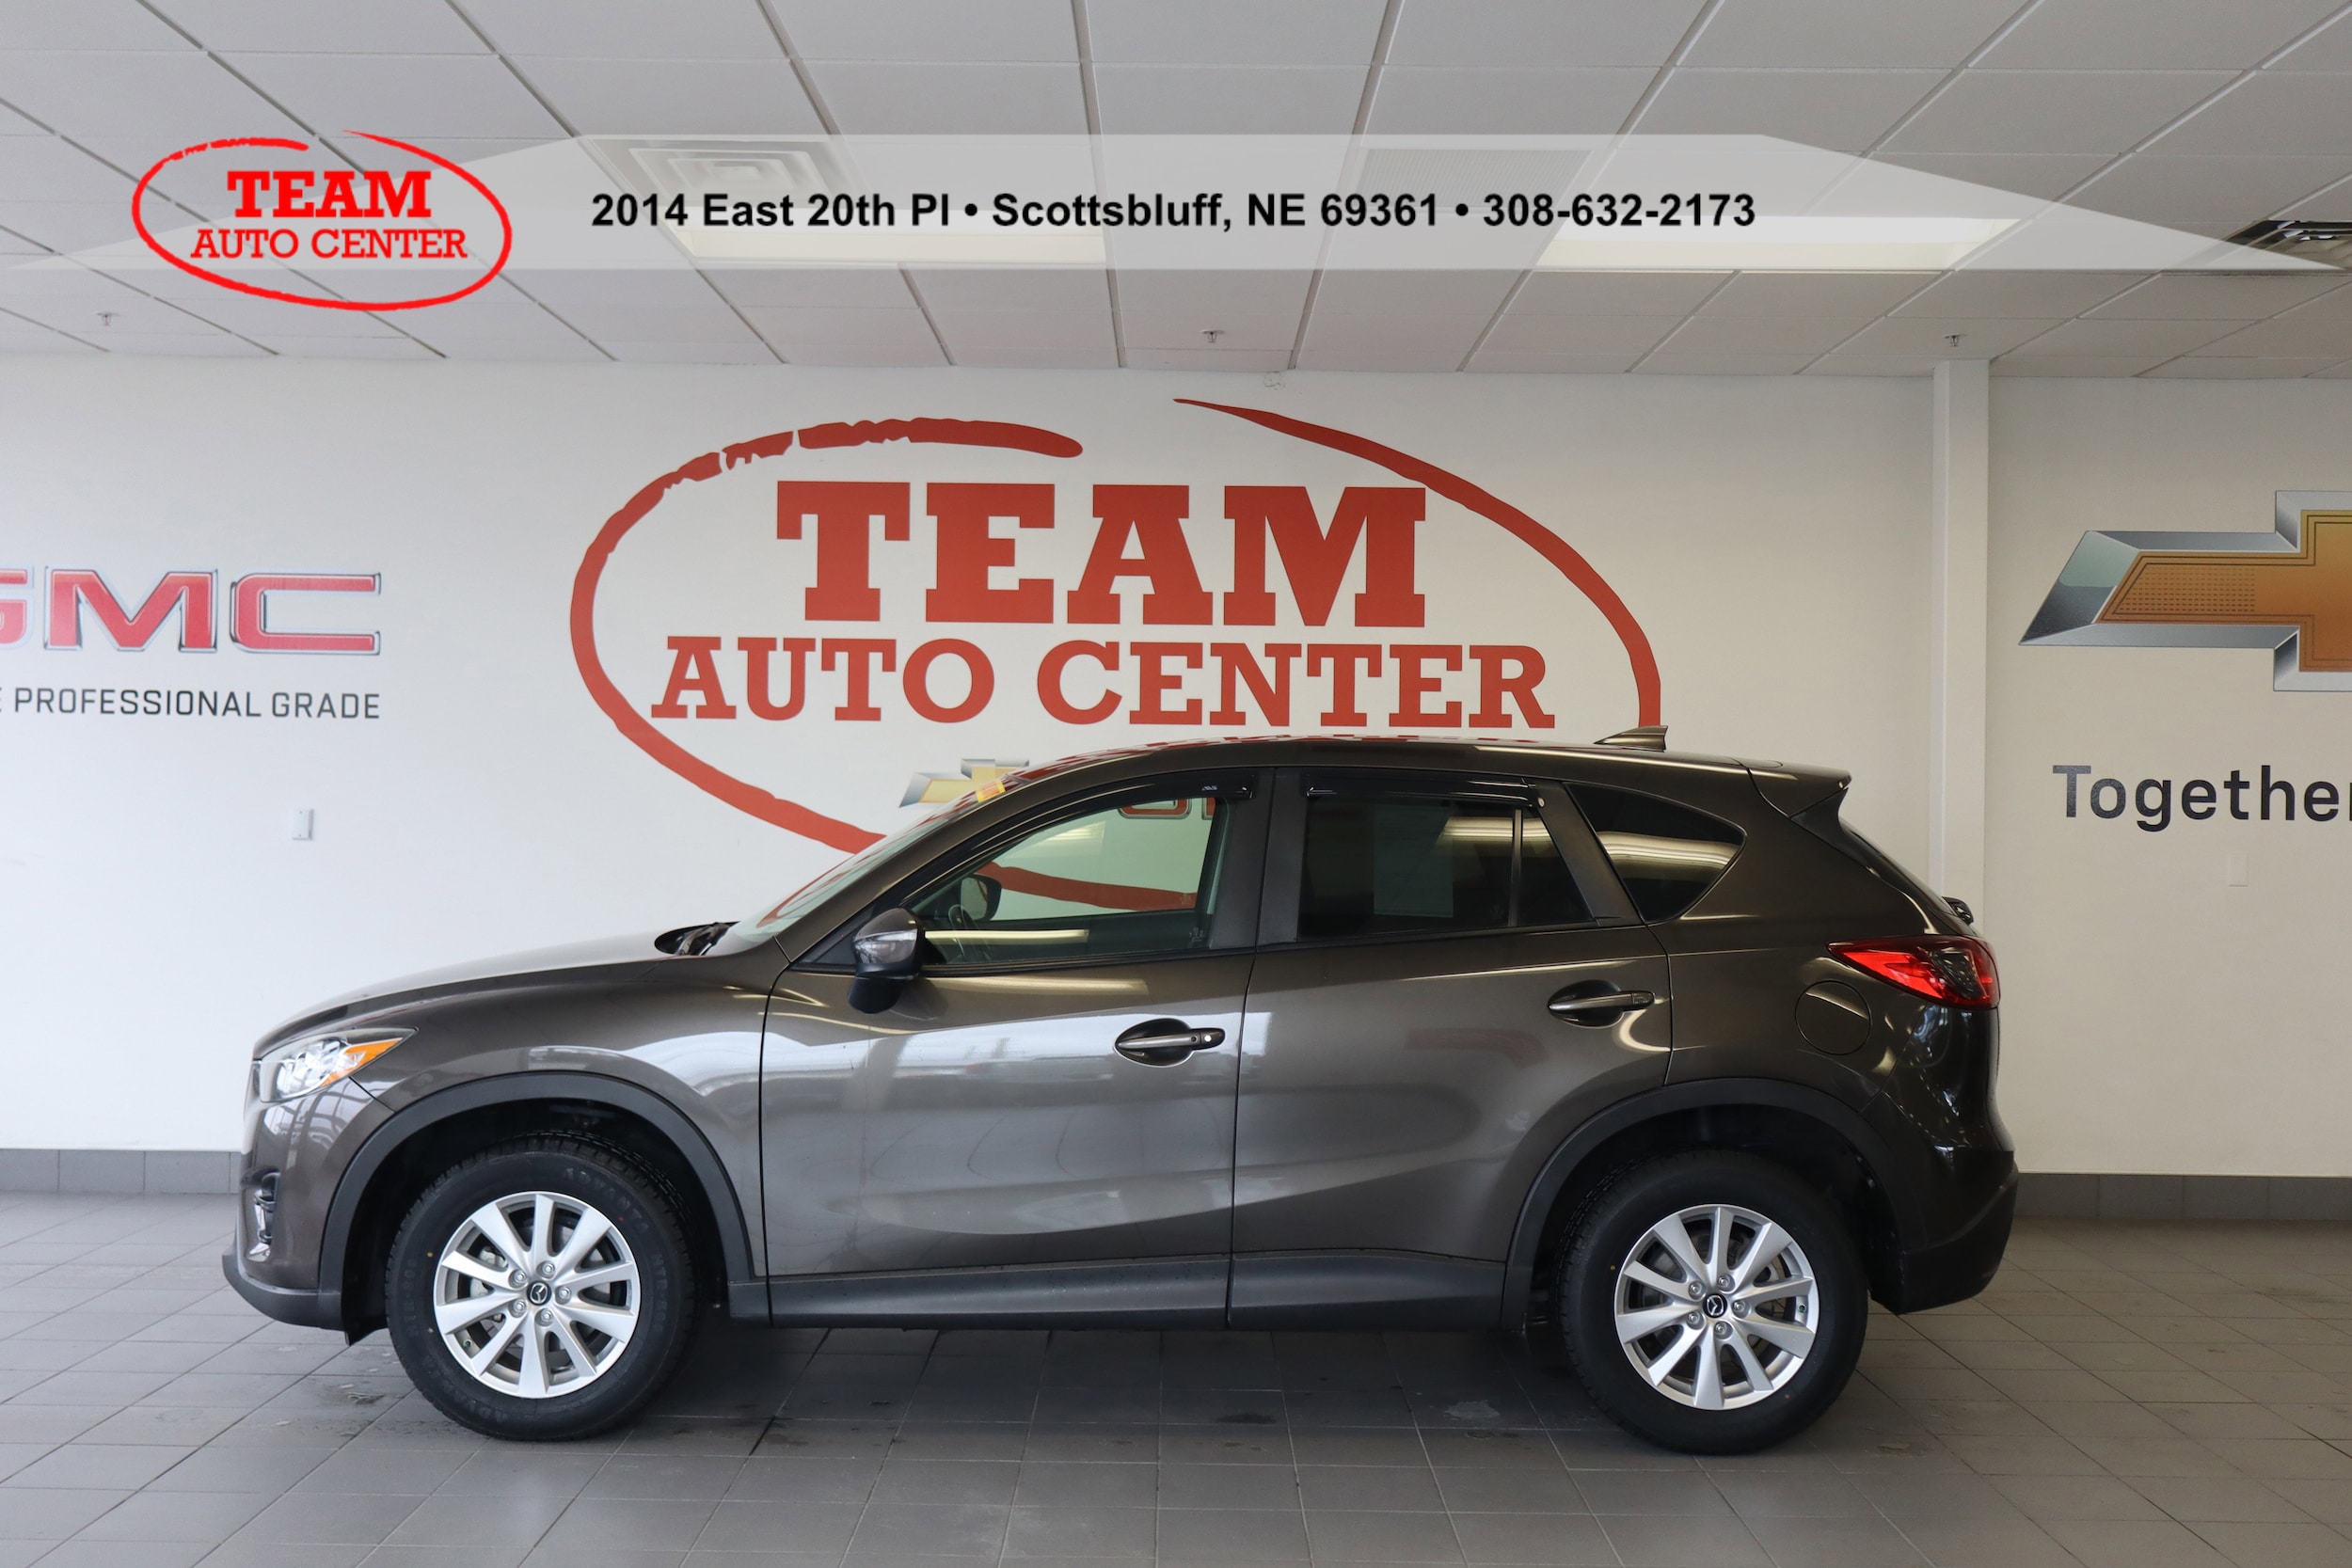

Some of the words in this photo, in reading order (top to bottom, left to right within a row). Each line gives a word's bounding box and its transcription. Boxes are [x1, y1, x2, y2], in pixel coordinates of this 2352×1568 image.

[776, 480, 1426, 628] TEAM
[0, 565, 381, 656] MC
[14, 687, 262, 718] PROFESSIONAL
[271, 691, 380, 720] GRADE
[650, 635, 995, 723] AUTO
[1036, 639, 1555, 729] CENTER
[2052, 764, 2352, 832] Togethe
